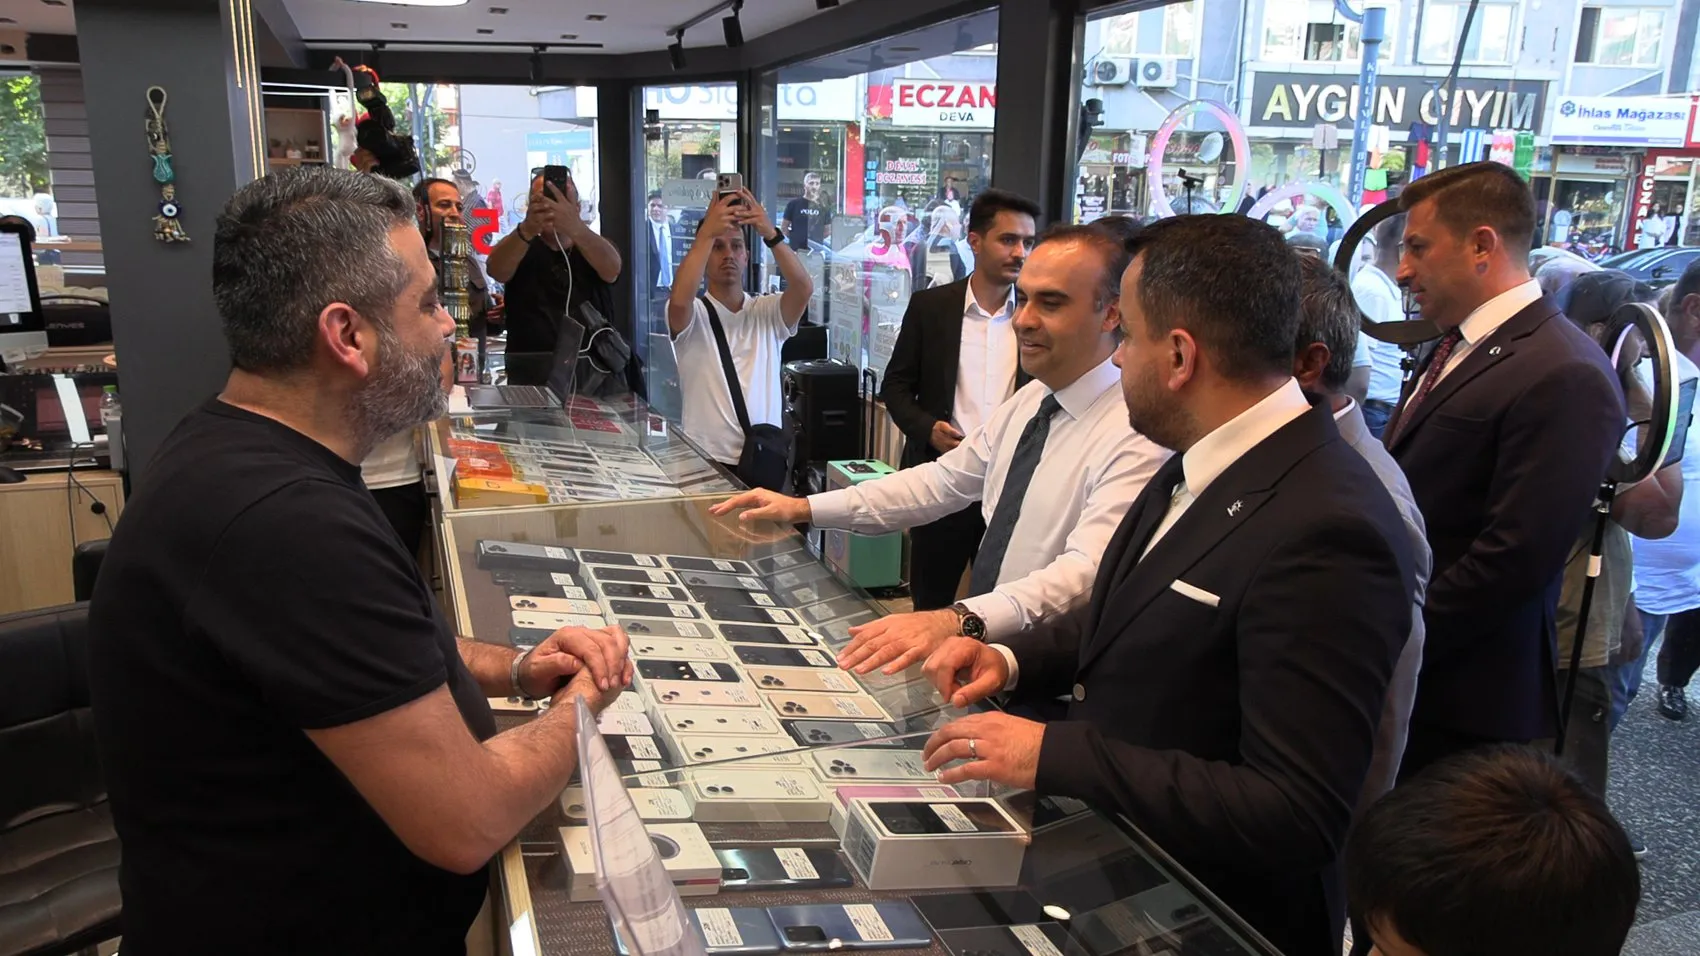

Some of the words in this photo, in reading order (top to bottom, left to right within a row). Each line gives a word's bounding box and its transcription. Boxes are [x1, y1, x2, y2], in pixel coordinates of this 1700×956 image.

[899, 84, 997, 108] ECZAN
[939, 112, 974, 122] DEVA
[886, 160, 918, 172] DEVA
[1633, 165, 1655, 245] ECZANE
